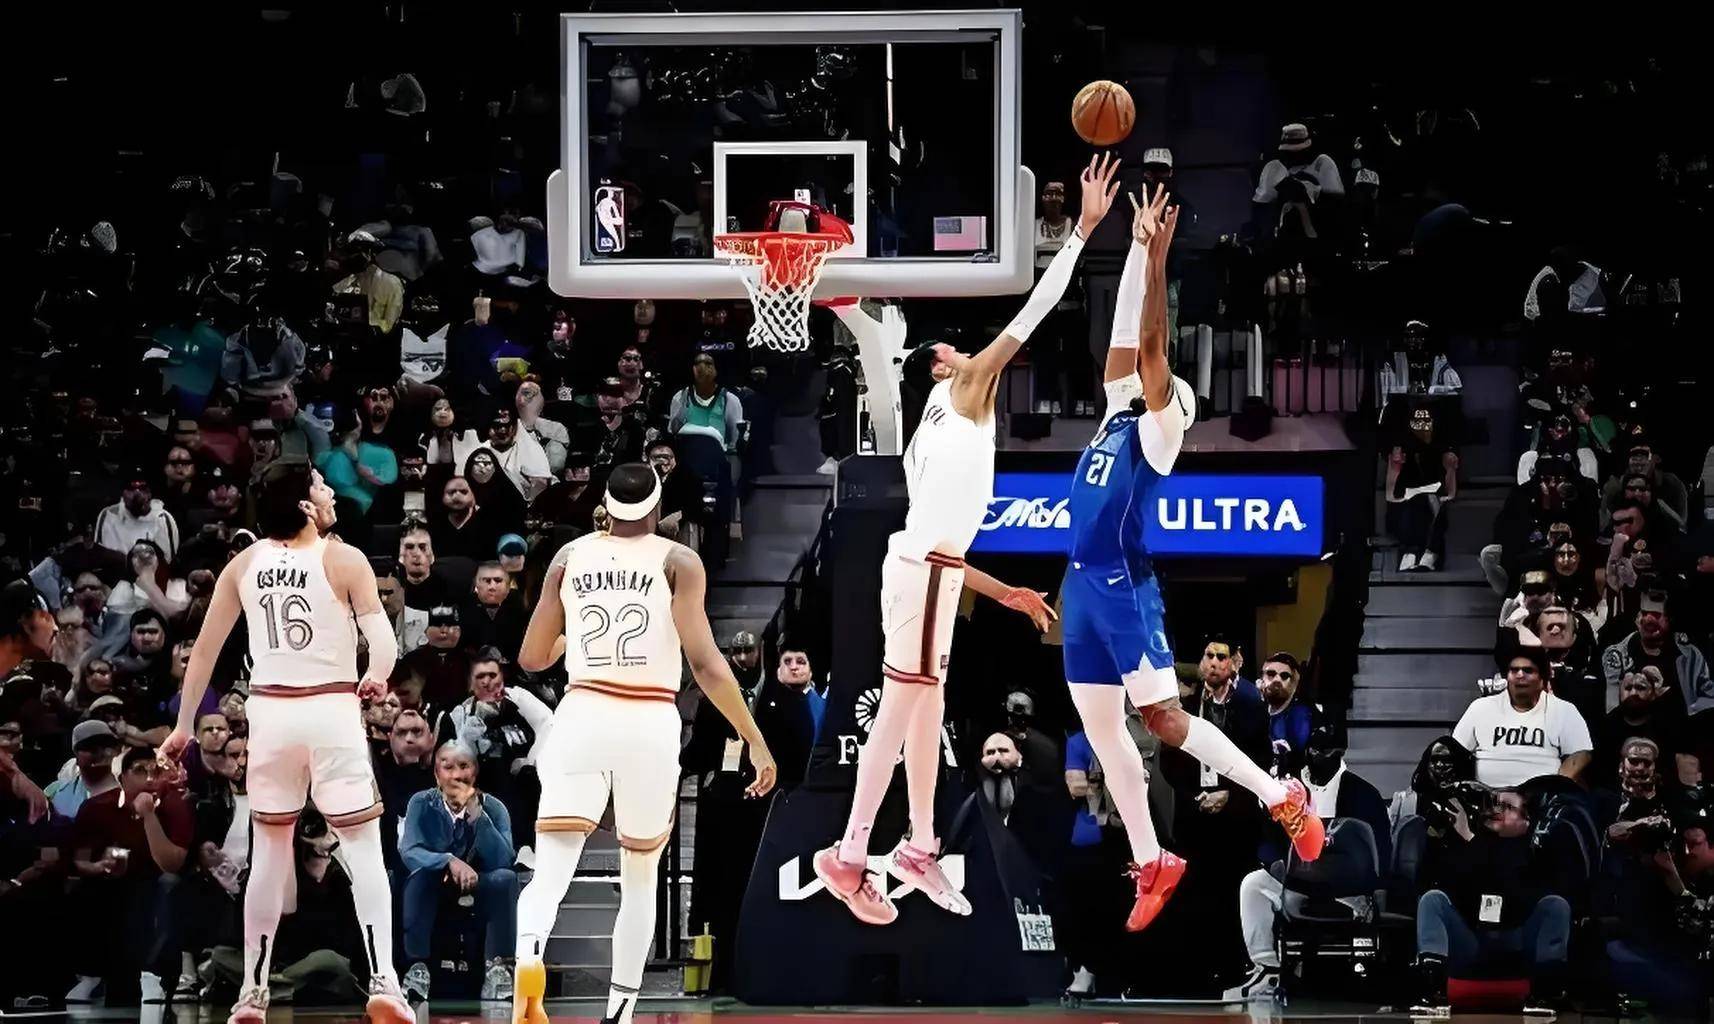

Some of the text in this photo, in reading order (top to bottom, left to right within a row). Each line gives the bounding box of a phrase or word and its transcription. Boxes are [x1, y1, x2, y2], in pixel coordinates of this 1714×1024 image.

[1086, 453, 1115, 487] 21
[1158, 498, 1306, 532] ULTRA
[259, 594, 313, 651] 16
[580, 603, 649, 667] 22
[1493, 726, 1545, 748] POLO
